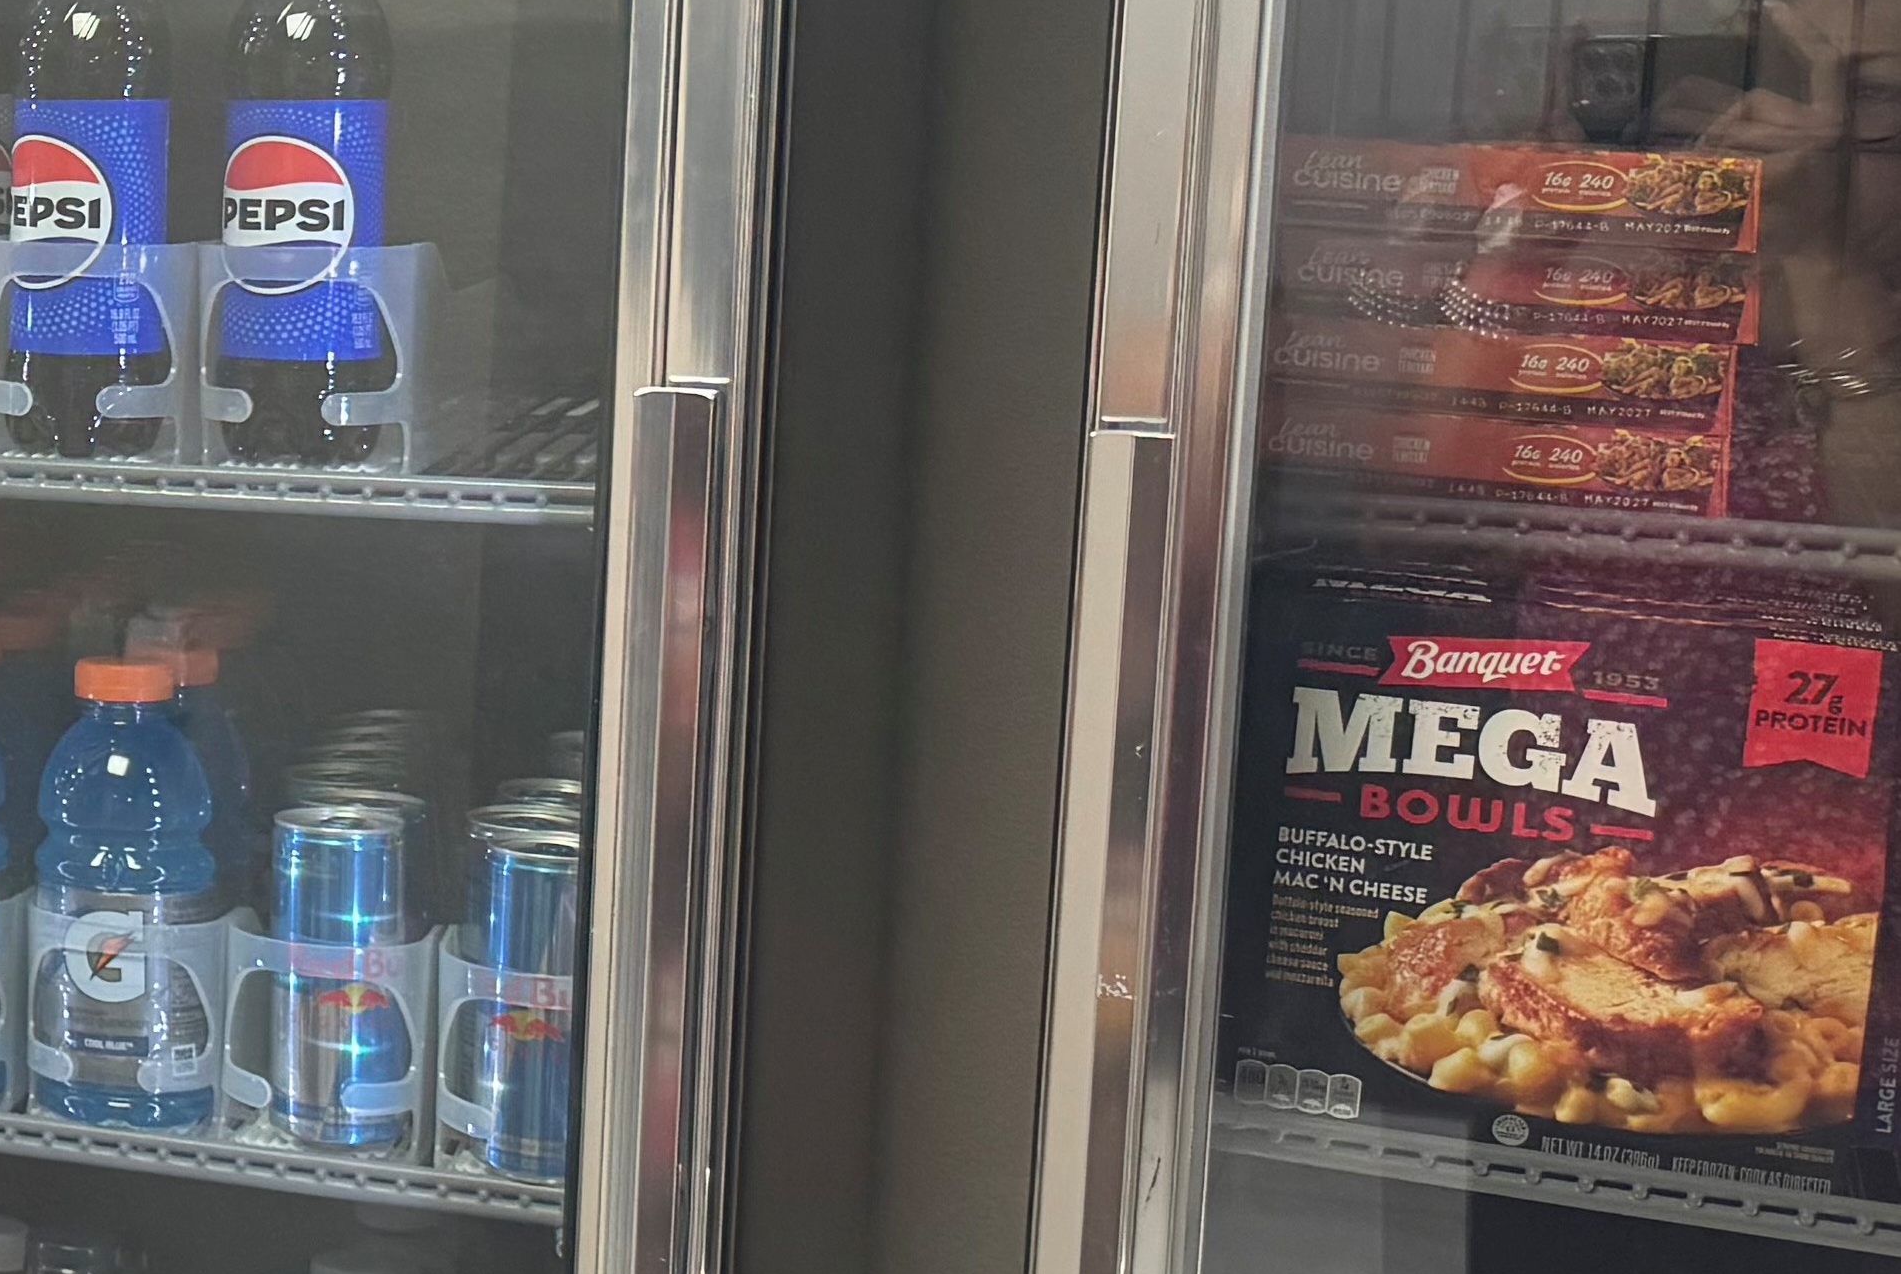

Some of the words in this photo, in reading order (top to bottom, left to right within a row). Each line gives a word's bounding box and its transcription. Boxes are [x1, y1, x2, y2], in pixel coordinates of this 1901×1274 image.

[224, 198, 344, 232] PEPSI
[1588, 404, 1652, 419] MAY2027
[1302, 639, 1378, 662] SINCE
[1399, 638, 1561, 682] Banquet
[1593, 670, 1662, 692] 1953
[1754, 707, 1868, 739] PROTEIN
[1286, 686, 1656, 819] MEGA
[1360, 784, 1575, 843] BOWLS
[1275, 846, 1365, 875] CHICKEN
[1278, 826, 1433, 862] BUFFALO-STYLE
[1273, 868, 1318, 892] MAC
[1348, 875, 1428, 906] CHEESE
